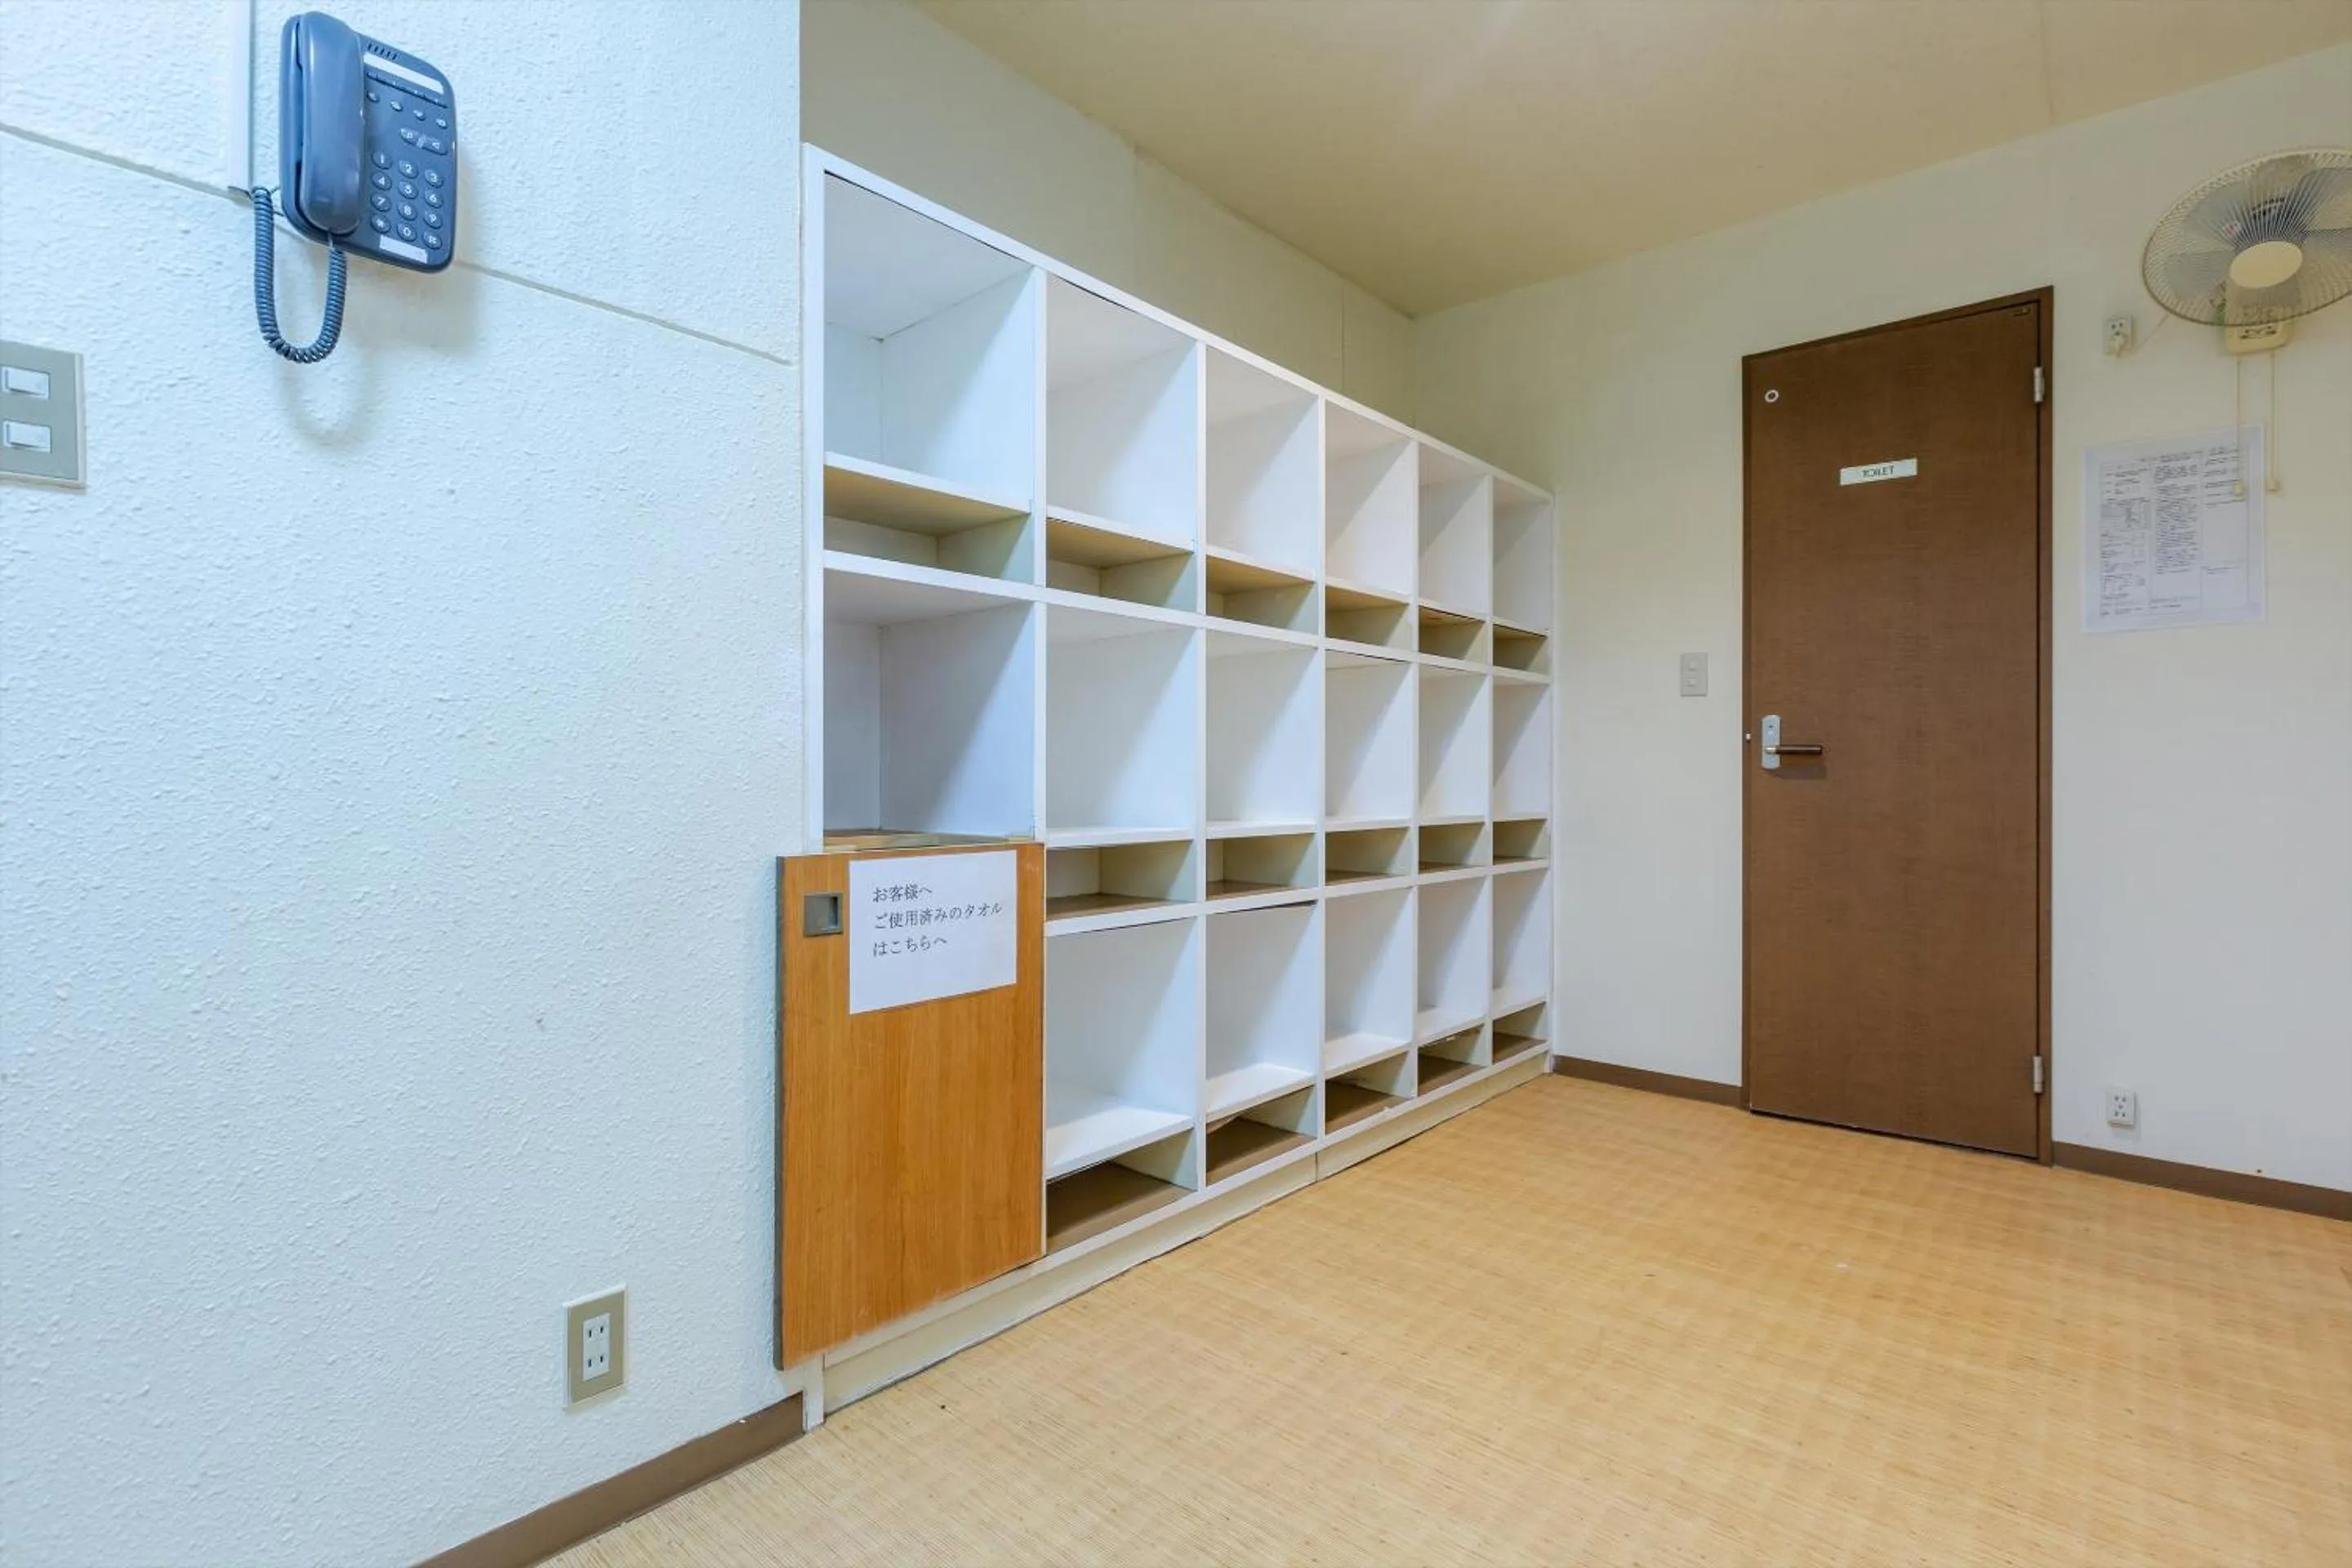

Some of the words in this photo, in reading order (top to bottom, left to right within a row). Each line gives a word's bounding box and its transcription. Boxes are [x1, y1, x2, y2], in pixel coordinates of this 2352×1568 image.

[405, 163, 412, 175] 2
[430, 172, 438, 183] 3
[378, 176, 385, 185] 4
[430, 194, 437, 203] 6
[377, 196, 386, 206] 7
[403, 204, 412, 216] 8
[429, 213, 437, 223] 9
[403, 227, 412, 236] 0
[872, 884, 933, 903] お客様へ
[875, 902, 1003, 929] ご使用済みのタオル
[872, 935, 948, 957] はこちらへ
